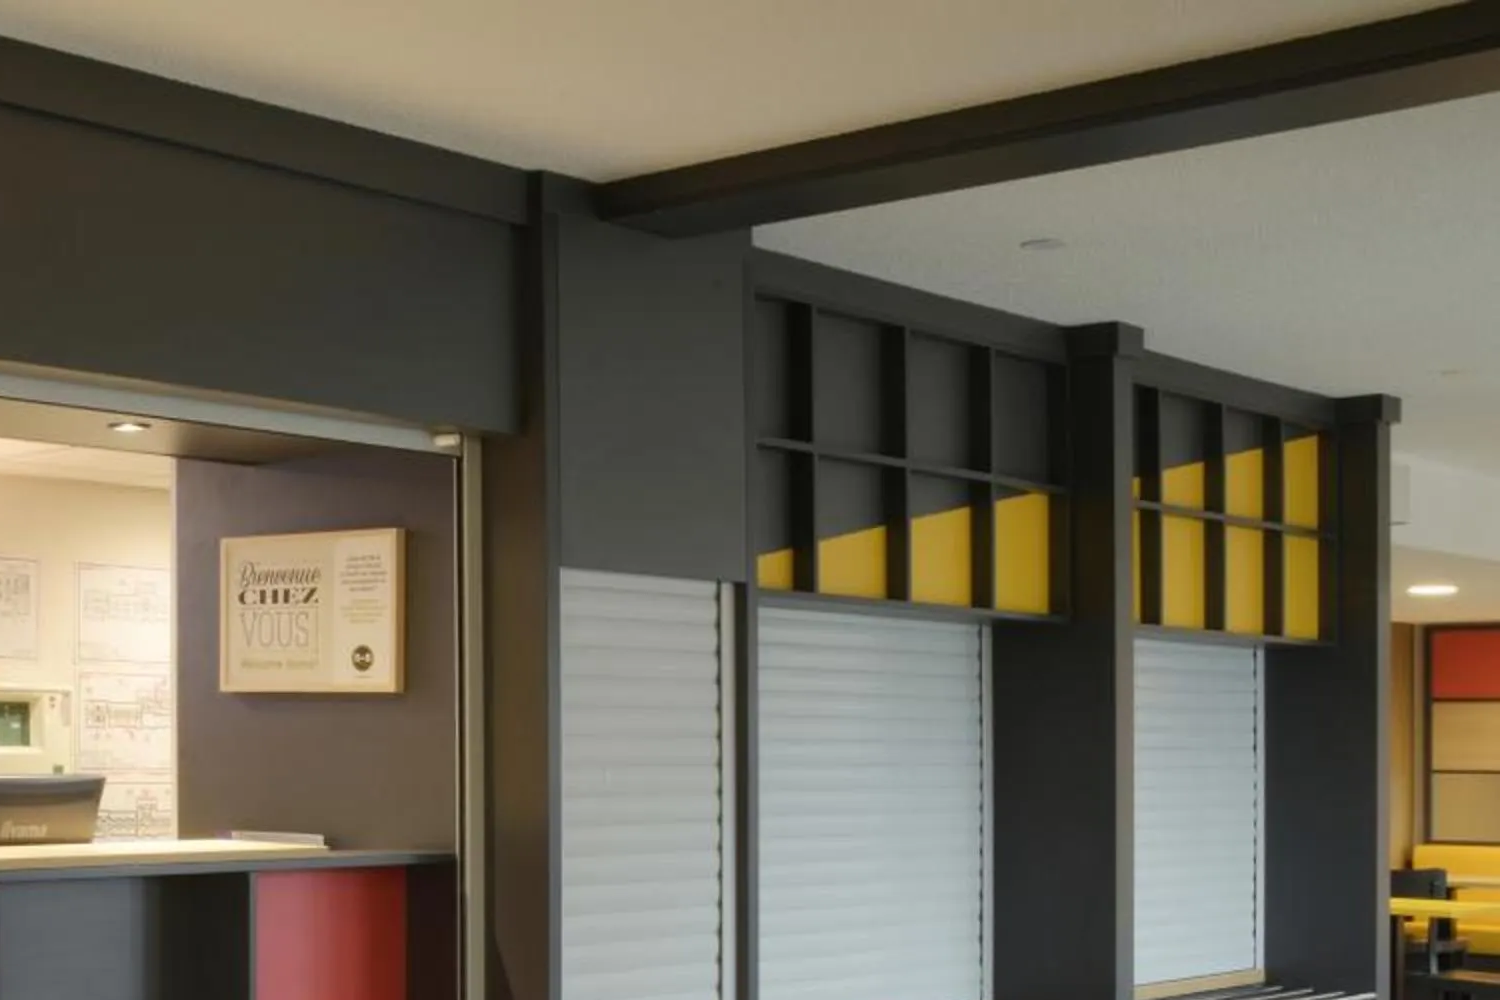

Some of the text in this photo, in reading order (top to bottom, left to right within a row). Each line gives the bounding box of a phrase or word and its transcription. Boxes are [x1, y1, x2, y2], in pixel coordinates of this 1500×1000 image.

[239, 561, 322, 589] Bienvenue
[238, 587, 319, 605] CHEZ
[240, 611, 310, 648] VOUS
